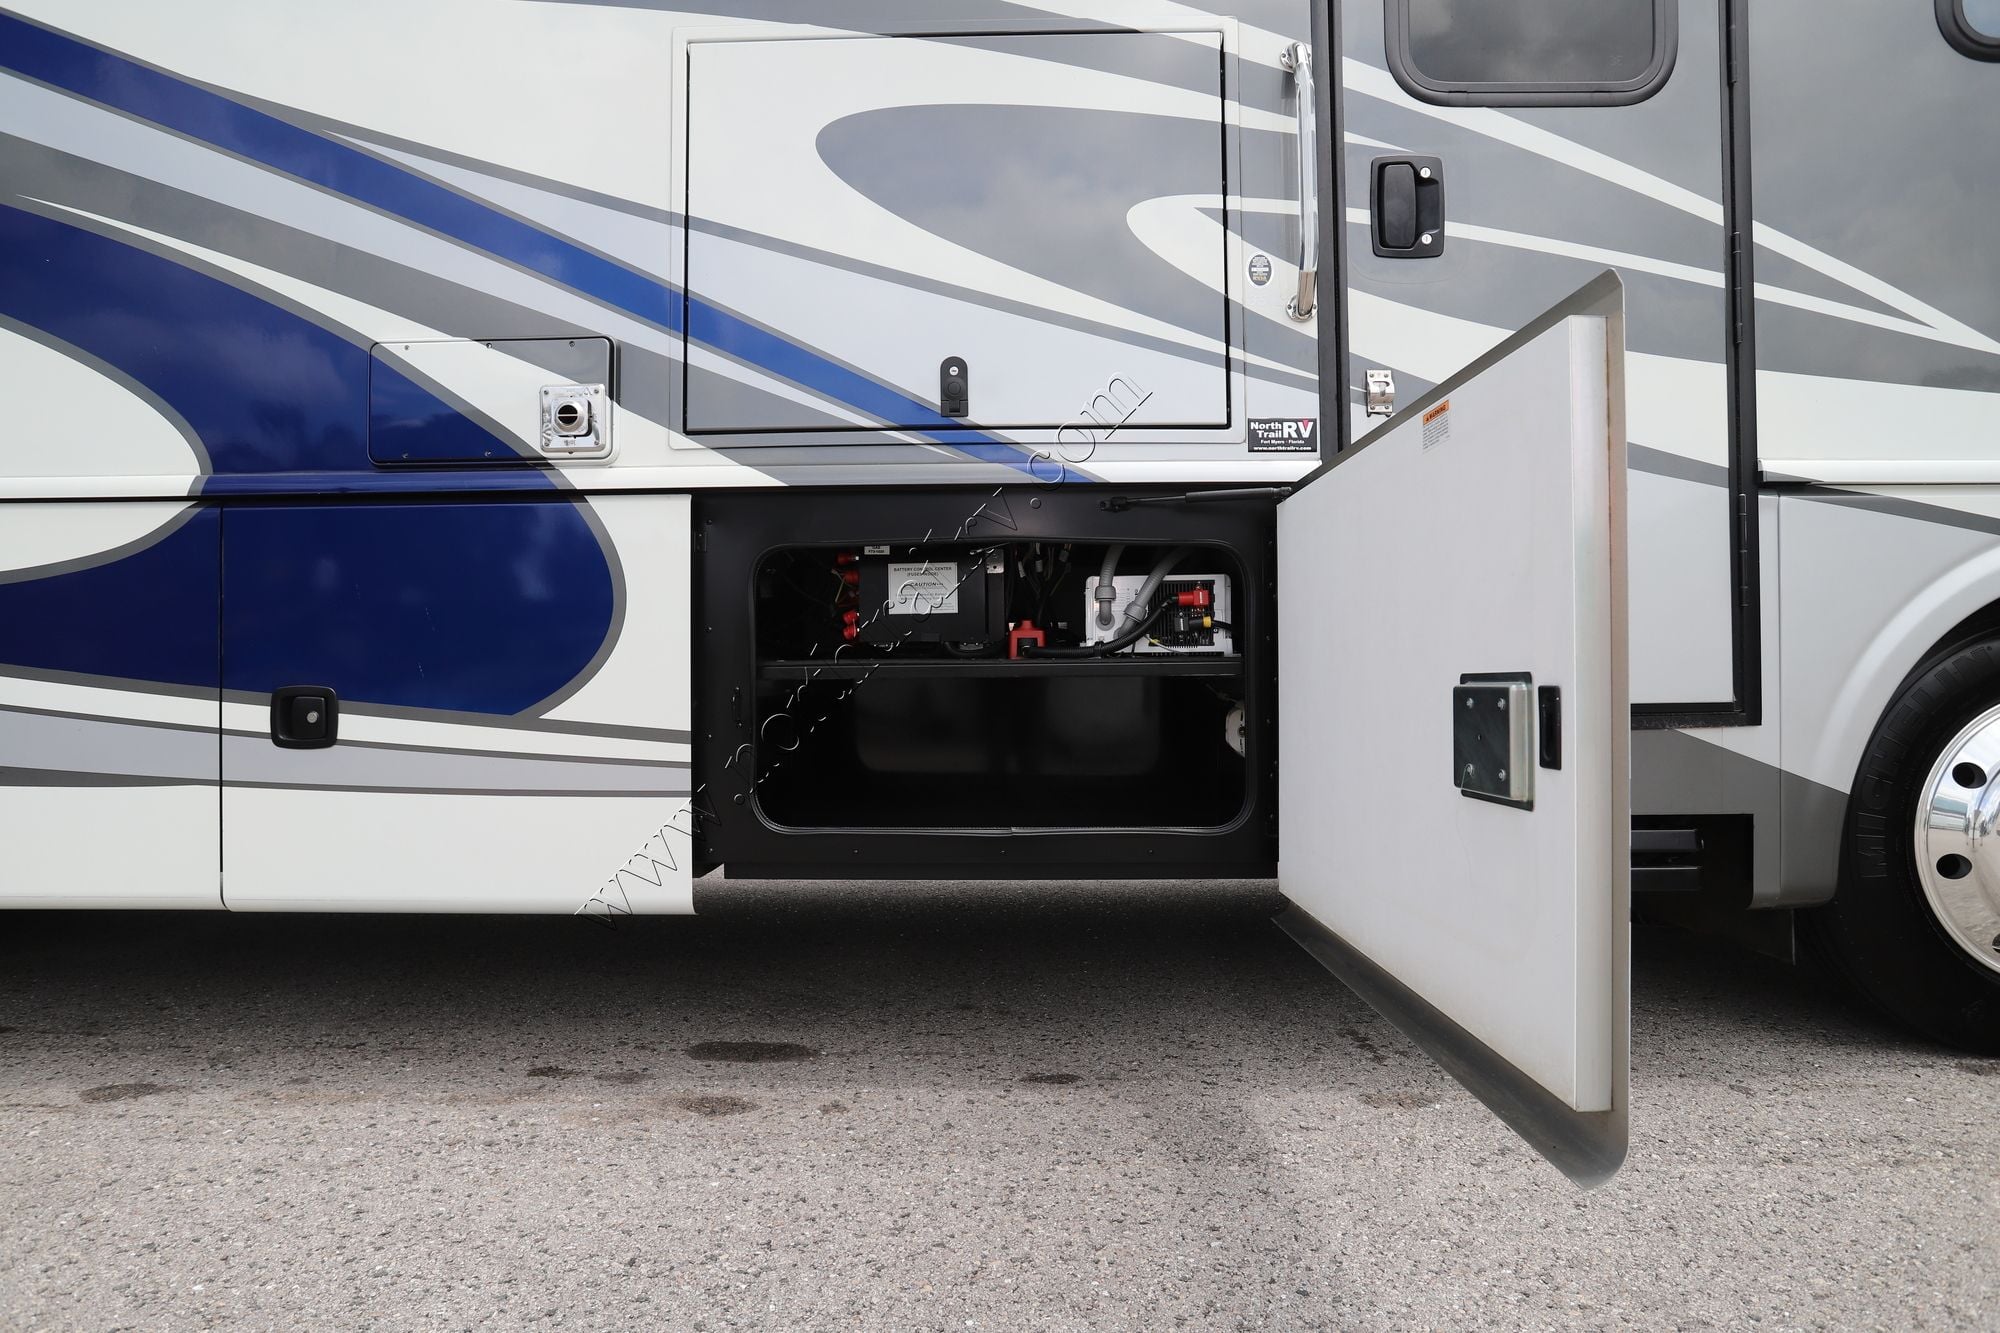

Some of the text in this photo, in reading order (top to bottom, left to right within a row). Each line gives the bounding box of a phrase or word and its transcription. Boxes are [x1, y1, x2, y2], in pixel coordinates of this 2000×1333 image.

[1250, 421, 1282, 430] North
[1282, 421, 1314, 438] RV
[1256, 430, 1282, 438] Trail
[1855, 646, 1995, 878] MICHELIN
